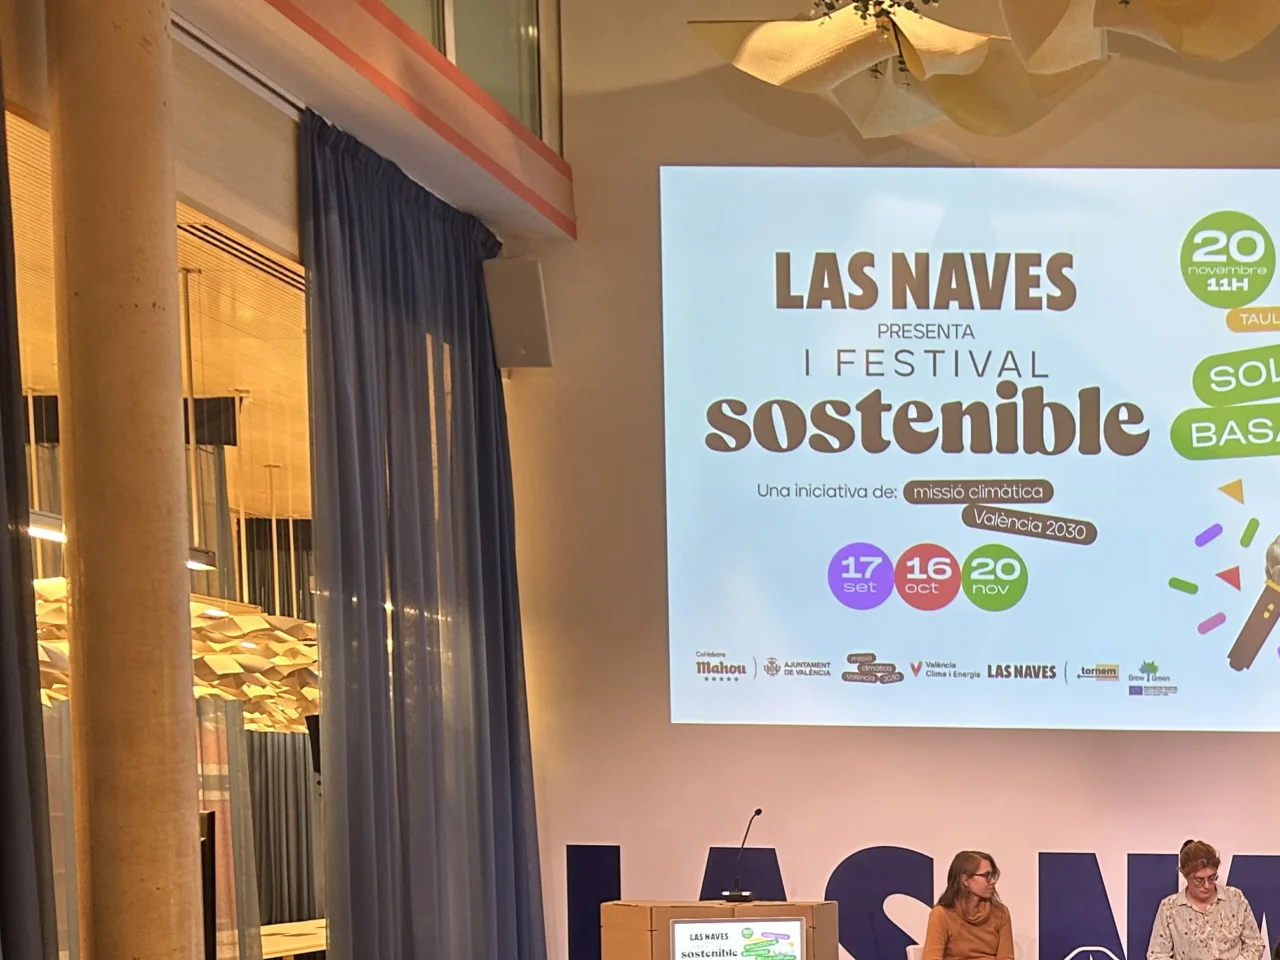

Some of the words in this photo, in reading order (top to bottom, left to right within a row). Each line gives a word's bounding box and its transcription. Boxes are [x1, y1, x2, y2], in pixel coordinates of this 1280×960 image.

[1191, 229, 1266, 263] 20
[1187, 264, 1268, 276] novembre
[774, 251, 879, 311] LAS
[891, 251, 1078, 312] NAVES
[1206, 277, 1250, 292] 11H
[877, 322, 976, 340] PRESENTA
[803, 347, 811, 377] I
[835, 348, 1050, 379] FESTIVAL
[704, 379, 1151, 456] sostenible
[757, 483, 790, 498] Una
[795, 483, 868, 498] iniciativa
[872, 484, 898, 499] de:
[913, 484, 965, 499] missió
[968, 483, 1044, 499] climàtica
[973, 508, 1043, 535] València
[1045, 519, 1087, 541] 2030
[840, 556, 883, 580] 17
[905, 557, 953, 580] 16
[970, 557, 1021, 581] 20
[843, 581, 878, 594] set
[905, 582, 939, 594] oct
[972, 583, 1010, 596] nov
[695, 660, 747, 675] Mahou
[784, 661, 831, 669] AJUNTAMENT
[987, 664, 1013, 679] LAS
[1013, 664, 1058, 680] NAVES
[1080, 666, 1117, 676] tornem
[953, 671, 981, 680] Energia
[689, 933, 703, 941] LAS
[680, 948, 738, 959] sostenible
